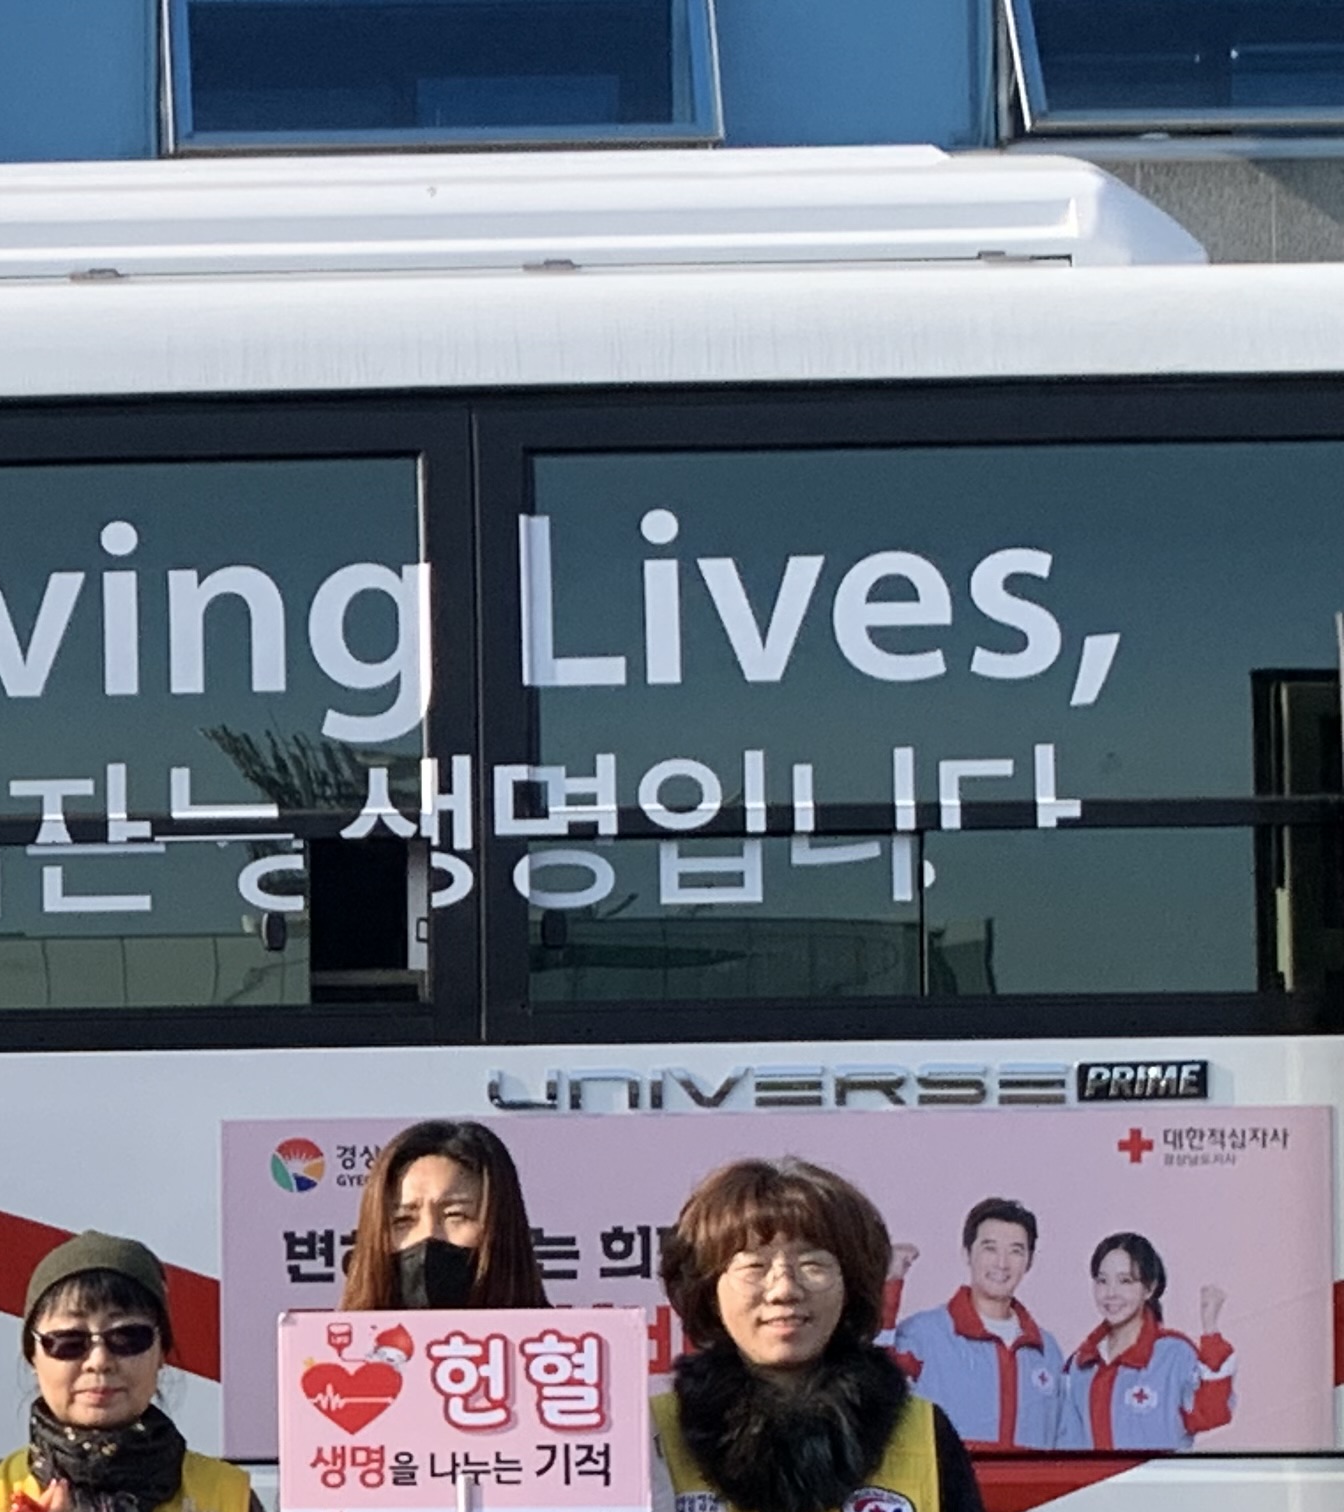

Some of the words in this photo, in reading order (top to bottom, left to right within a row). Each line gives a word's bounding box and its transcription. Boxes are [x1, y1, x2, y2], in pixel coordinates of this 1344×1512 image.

[521, 508, 1119, 705] Lives,
[488, 1060, 1067, 1111] UNIVERSE
[1085, 1063, 1204, 1098] PRIME
[1162, 1126, 1290, 1151] 대한적십자사
[426, 1328, 612, 1431] 헌혈
[310, 1444, 419, 1489] 생명을
[429, 1450, 524, 1487] 나누는
[535, 1442, 612, 1488] 기적
